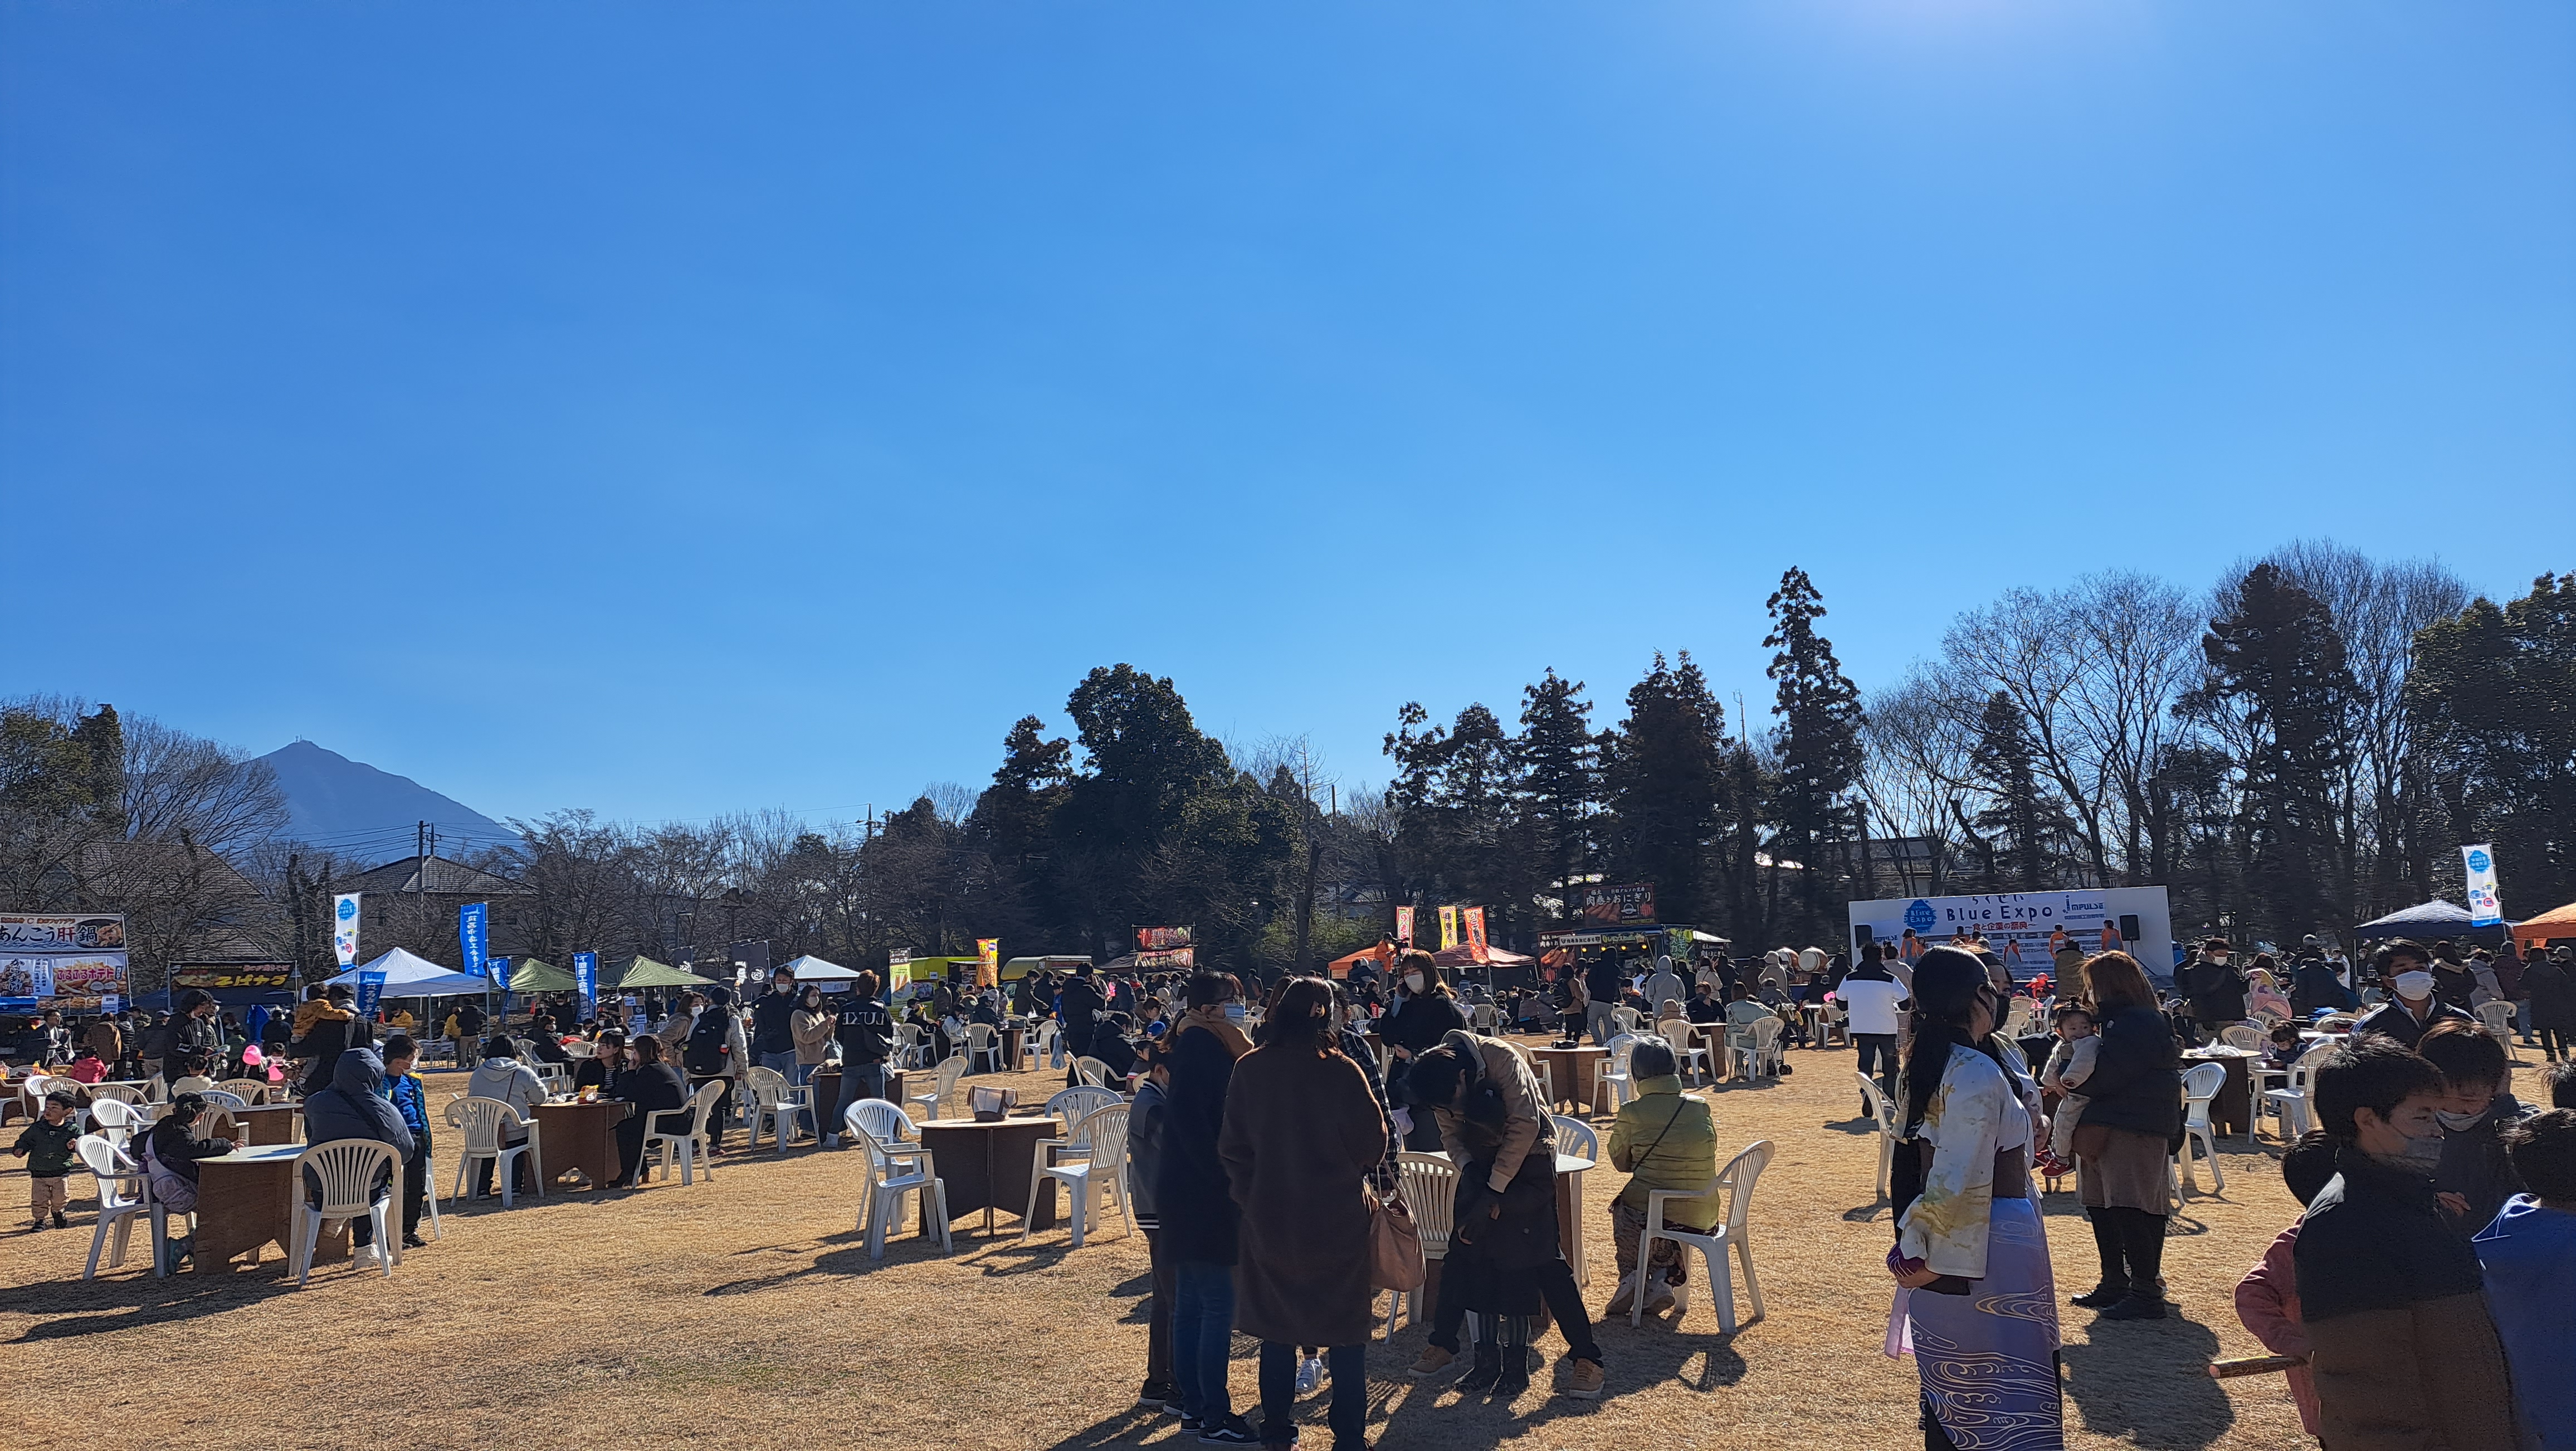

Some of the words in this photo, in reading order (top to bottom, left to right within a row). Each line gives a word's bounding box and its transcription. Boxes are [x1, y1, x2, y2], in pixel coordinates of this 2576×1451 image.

[1585, 892, 1651, 907] 肉巻きおにぎり
[1946, 907, 1992, 921] Blue
[2000, 905, 2053, 922] Expo
[0, 924, 99, 943] あんこう肝鍋
